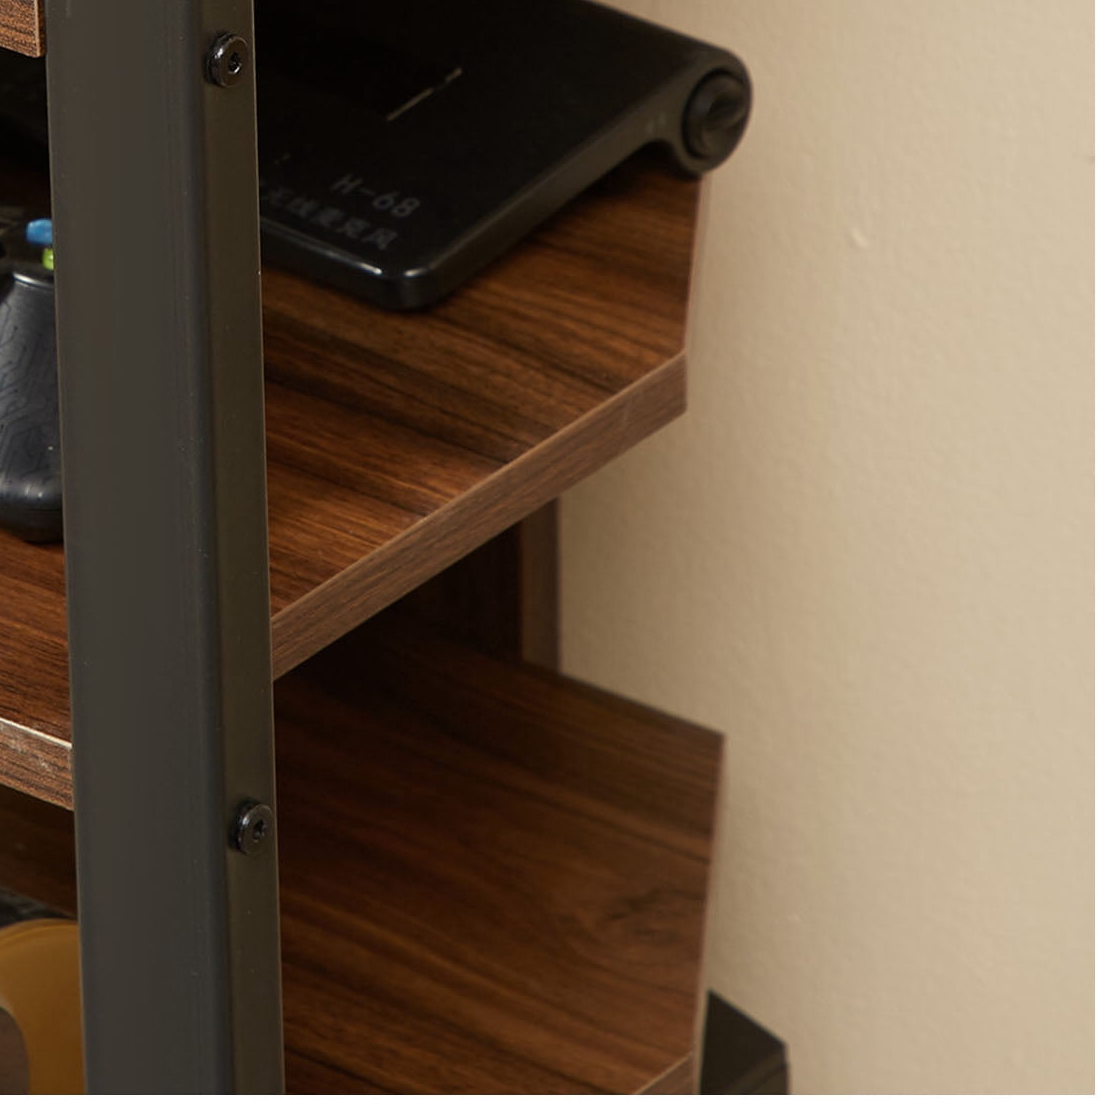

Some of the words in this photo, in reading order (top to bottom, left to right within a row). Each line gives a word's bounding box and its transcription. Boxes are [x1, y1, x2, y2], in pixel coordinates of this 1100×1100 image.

[261, 182, 398, 251] 无线麦克风
[330, 173, 421, 218] H-68
